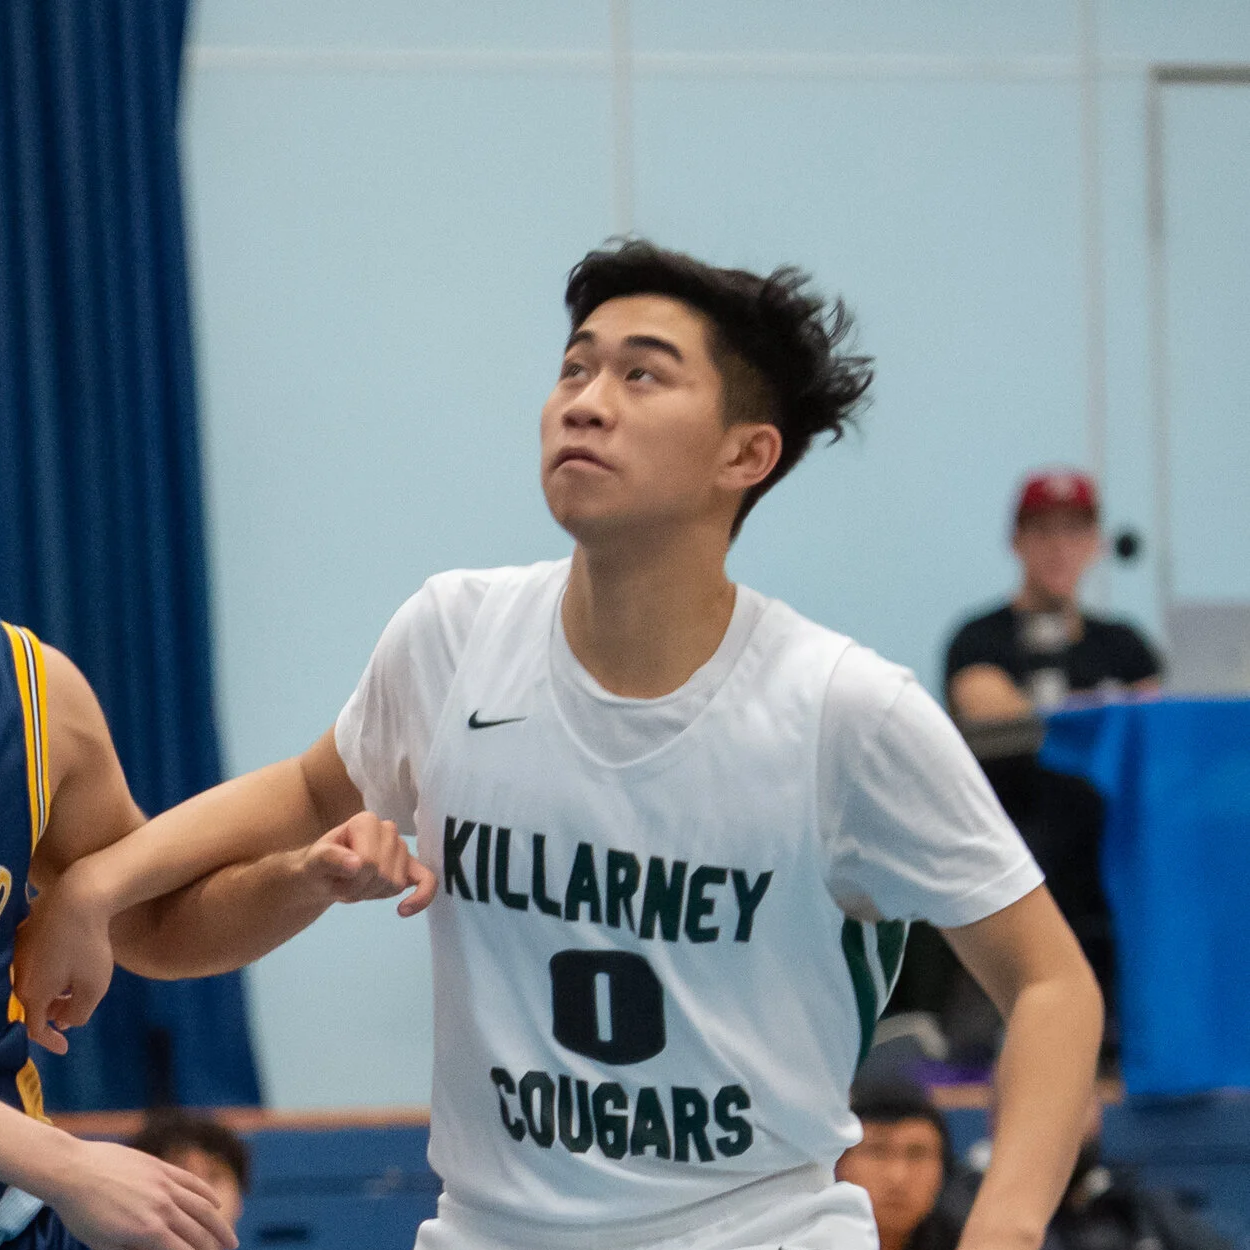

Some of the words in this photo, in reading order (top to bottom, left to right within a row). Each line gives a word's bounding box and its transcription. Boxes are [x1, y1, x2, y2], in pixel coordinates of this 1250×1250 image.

[443, 816, 774, 944] KILLARNEY
[550, 948, 667, 1066] 0
[490, 1066, 754, 1163] COUGARS
